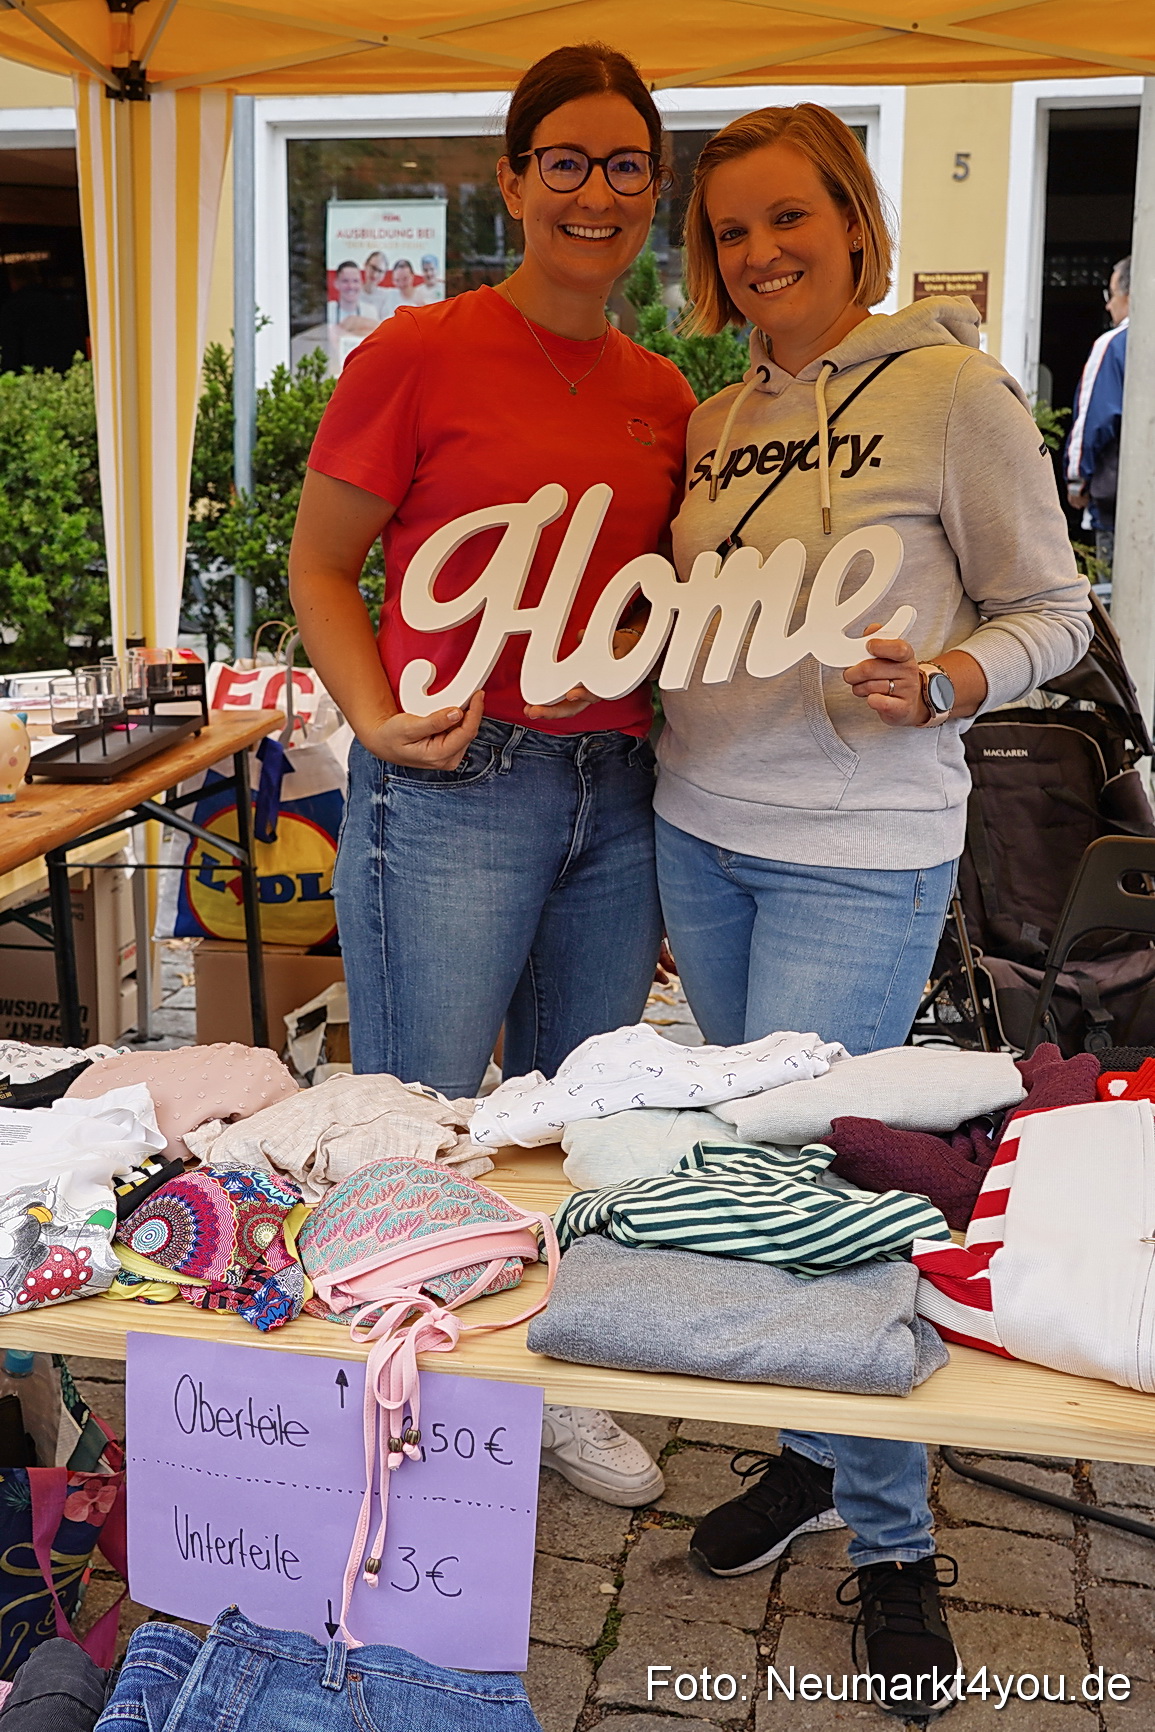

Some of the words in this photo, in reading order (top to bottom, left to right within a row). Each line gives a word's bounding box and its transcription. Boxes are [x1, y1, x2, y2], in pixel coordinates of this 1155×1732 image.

[952, 152, 971, 183] 5
[336, 228, 414, 240] AUSBILDUNG
[417, 228, 436, 240] BEI
[689, 428, 884, 491] superdry.
[400, 483, 917, 717] Home
[983, 748, 1029, 758] MACLAREN
[0, 998, 89, 1023] UZUGSM
[174, 1374, 310, 1447] Oberteile
[174, 1505, 303, 1581] Unterteile
